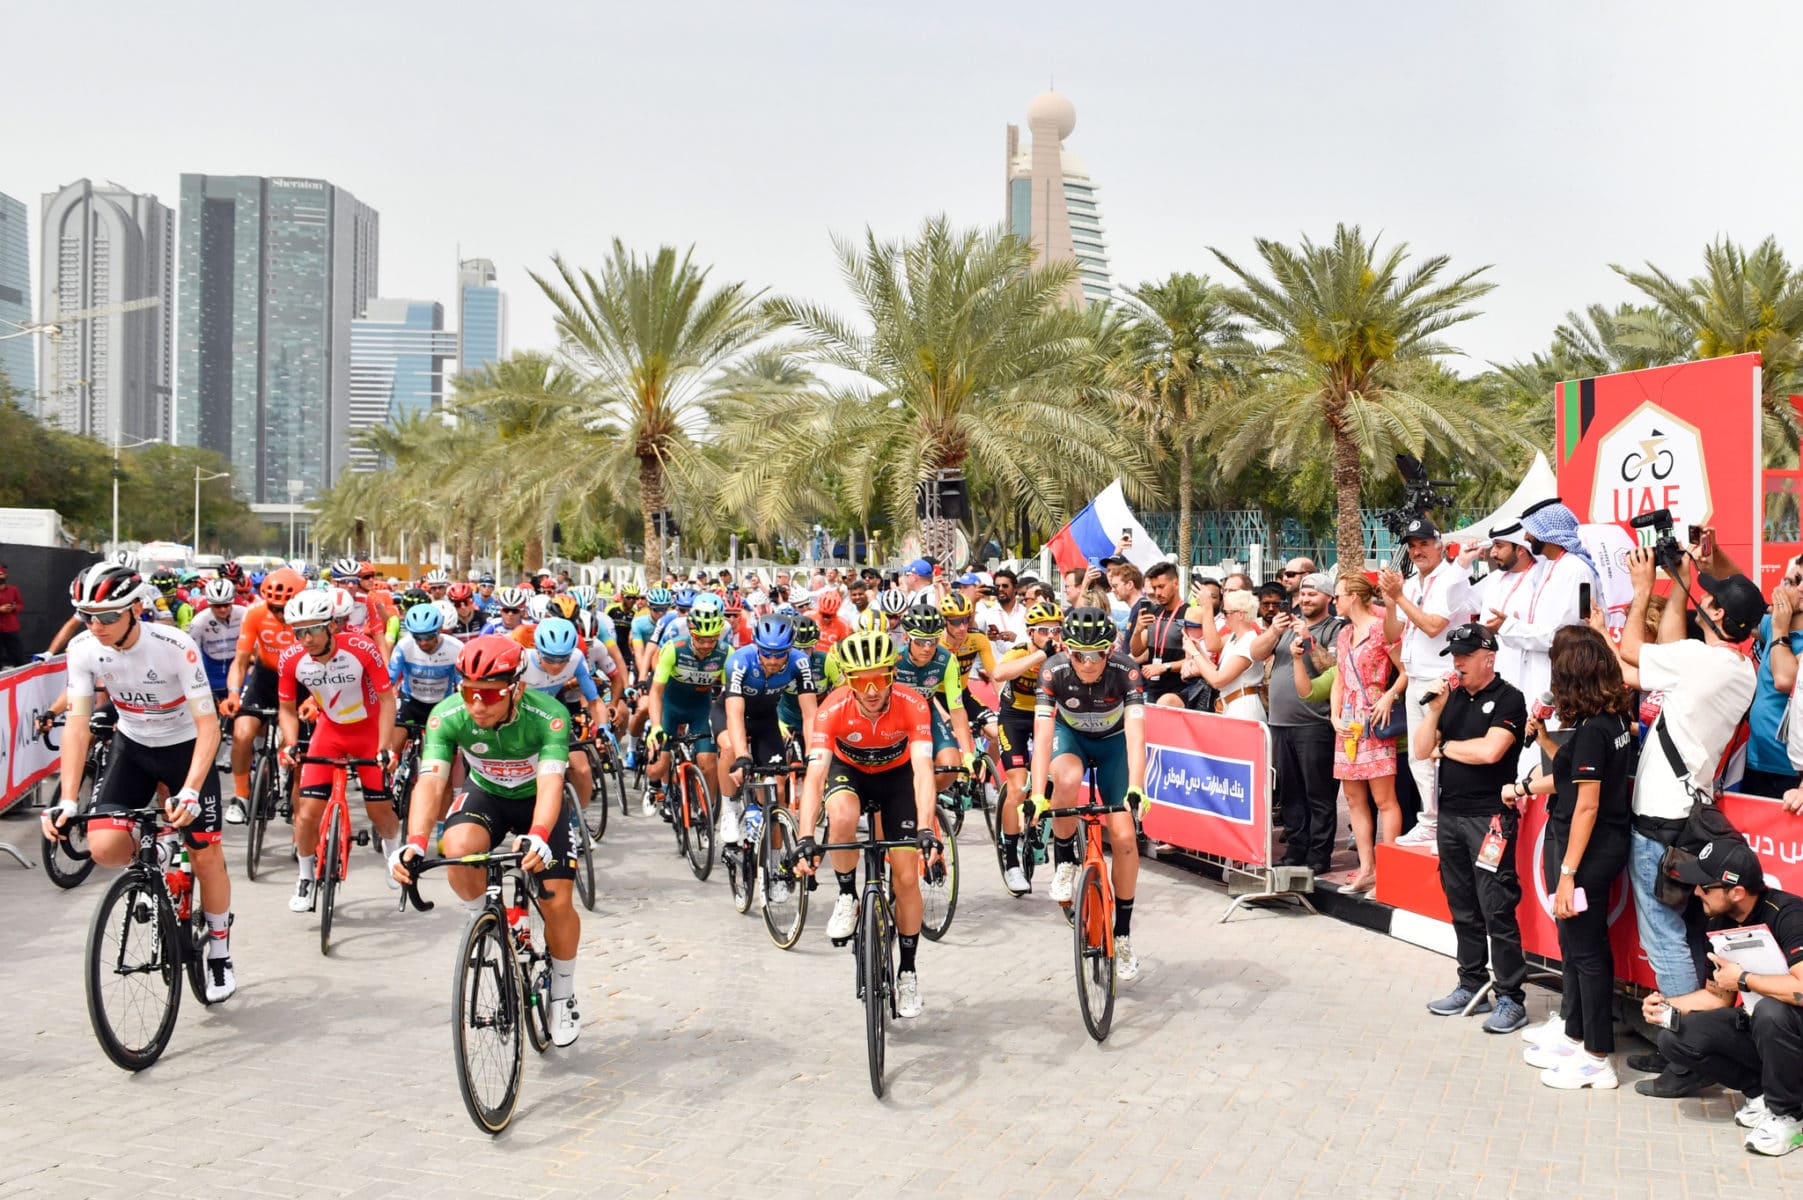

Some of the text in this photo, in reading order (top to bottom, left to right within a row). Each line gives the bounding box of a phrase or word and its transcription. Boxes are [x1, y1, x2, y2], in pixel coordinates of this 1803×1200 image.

[272, 178, 323, 190] Sheraton
[1613, 485, 1680, 524] UAE
[347, 637, 383, 668] Cofidis
[302, 672, 356, 687] Cofidis
[729, 659, 747, 695] BMC
[796, 657, 816, 691] BMC
[119, 692, 160, 703] UAE
[1162, 767, 1186, 790] الوطني
[1185, 777, 1200, 795] دبي
[1229, 780, 1244, 803] بنك
[204, 795, 217, 823] UAE
